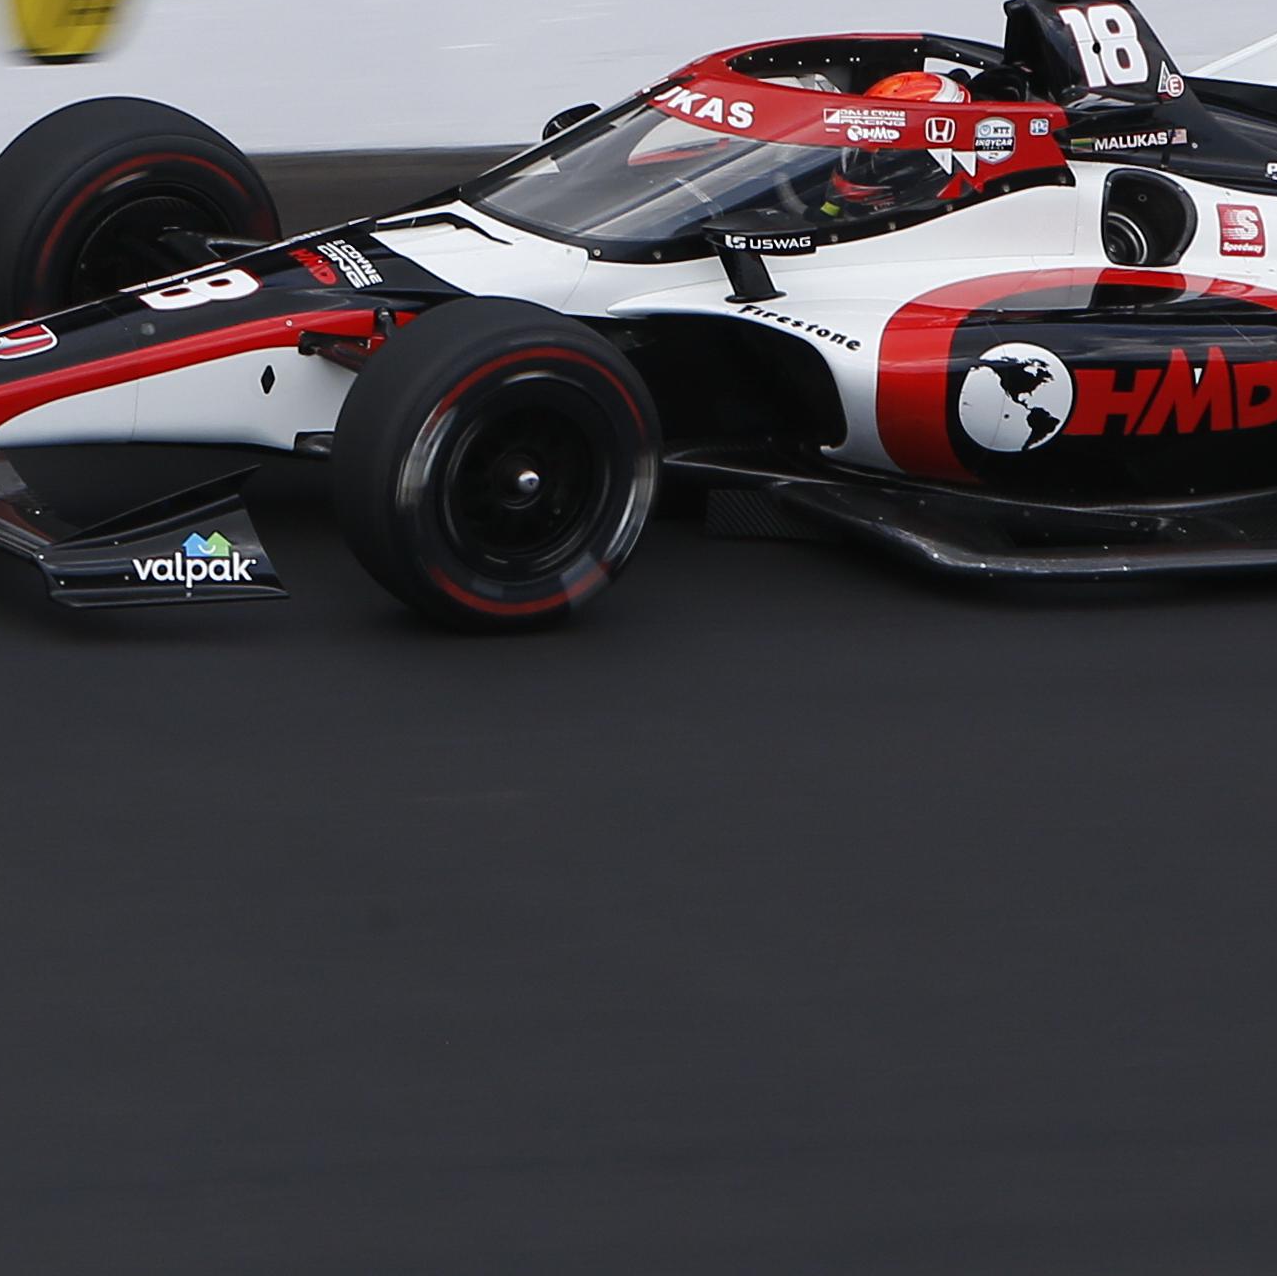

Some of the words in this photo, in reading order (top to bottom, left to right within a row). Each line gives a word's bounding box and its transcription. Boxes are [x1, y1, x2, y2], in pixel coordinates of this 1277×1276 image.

[1057, 3, 1149, 88] 18
[840, 108, 869, 117] DALE
[871, 109, 906, 117] COYNE
[840, 118, 906, 127] RACING
[862, 126, 900, 141] HMD
[992, 126, 1011, 135] NTT
[975, 138, 1014, 147] INDYCAR
[1094, 131, 1168, 151] MALUKAS
[750, 236, 812, 250] USWAG
[1222, 241, 1263, 255] Speedway
[340, 243, 384, 285] COYNE
[737, 304, 862, 352] Firestone
[132, 551, 253, 589] valpak
